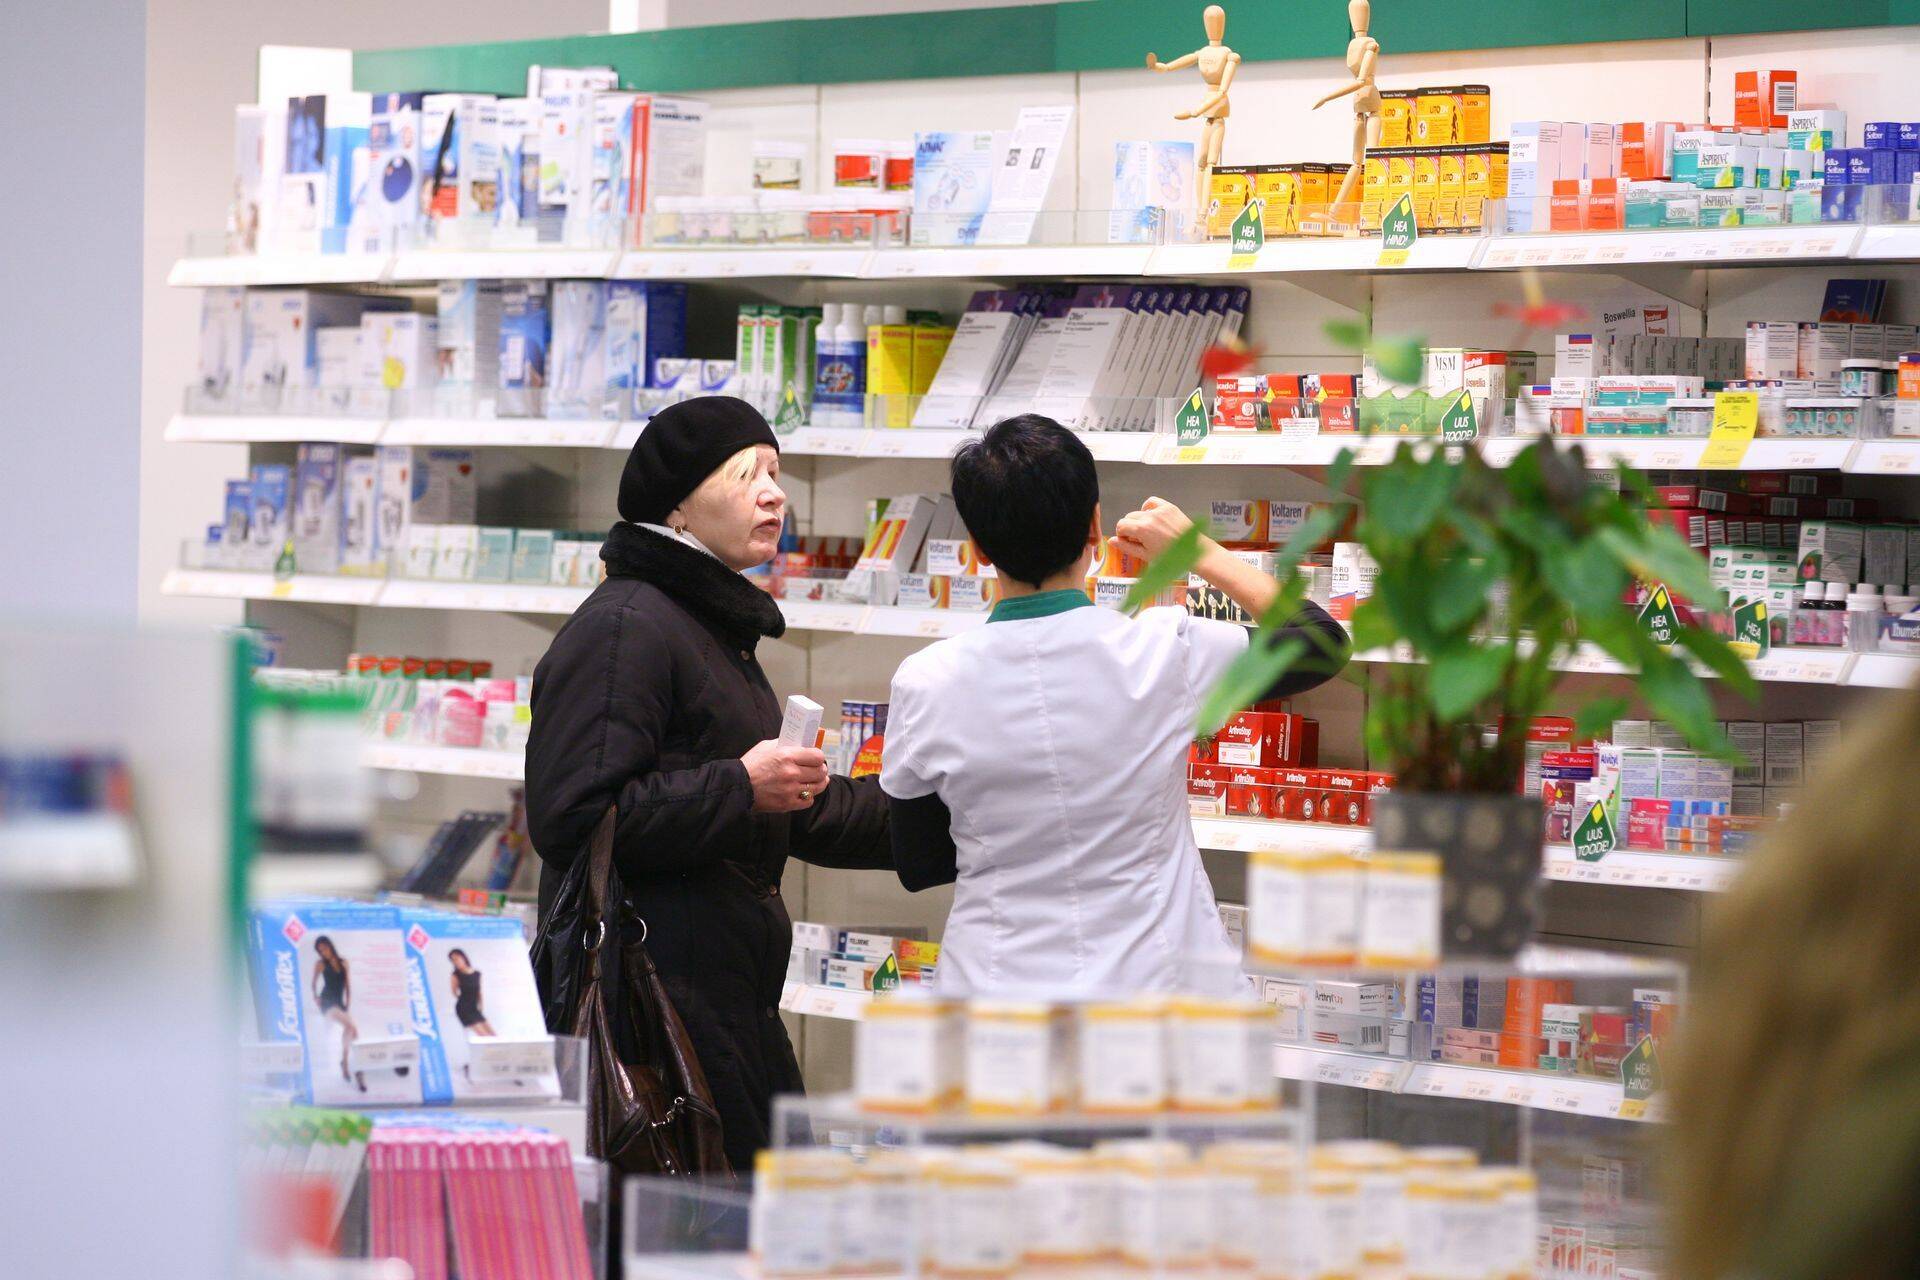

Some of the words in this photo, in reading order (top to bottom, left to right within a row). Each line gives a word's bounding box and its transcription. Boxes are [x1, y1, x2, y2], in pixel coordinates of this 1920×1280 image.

[1241, 225, 1255, 238] HEA
[1393, 220, 1407, 232] HEA
[1234, 238, 1256, 252] HIND!
[1386, 235, 1408, 246] HIND!
[1603, 308, 1636, 324] Boswellia
[1434, 355, 1456, 371] MSM
[1186, 415, 1200, 427] HEA
[1454, 416, 1469, 429] UUS
[1180, 429, 1201, 440] HIND!
[1211, 502, 1242, 516] Voltaren
[1271, 503, 1302, 518] Voltaren
[929, 542, 953, 552] Voltaren
[900, 575, 924, 587] Voltaren
[951, 577, 976, 590] Voltaren
[1097, 580, 1127, 594] Voltaren
[1651, 615, 1667, 628] HEA
[1745, 620, 1762, 640] HEA
[1234, 773, 1256, 784] ArthroStop
[1286, 773, 1307, 784] ArthroStop
[1331, 775, 1353, 787] ArthroStop
[1586, 827, 1603, 842] UUS
[1577, 841, 1609, 858] TOODE!
[882, 978, 896, 988] UUS
